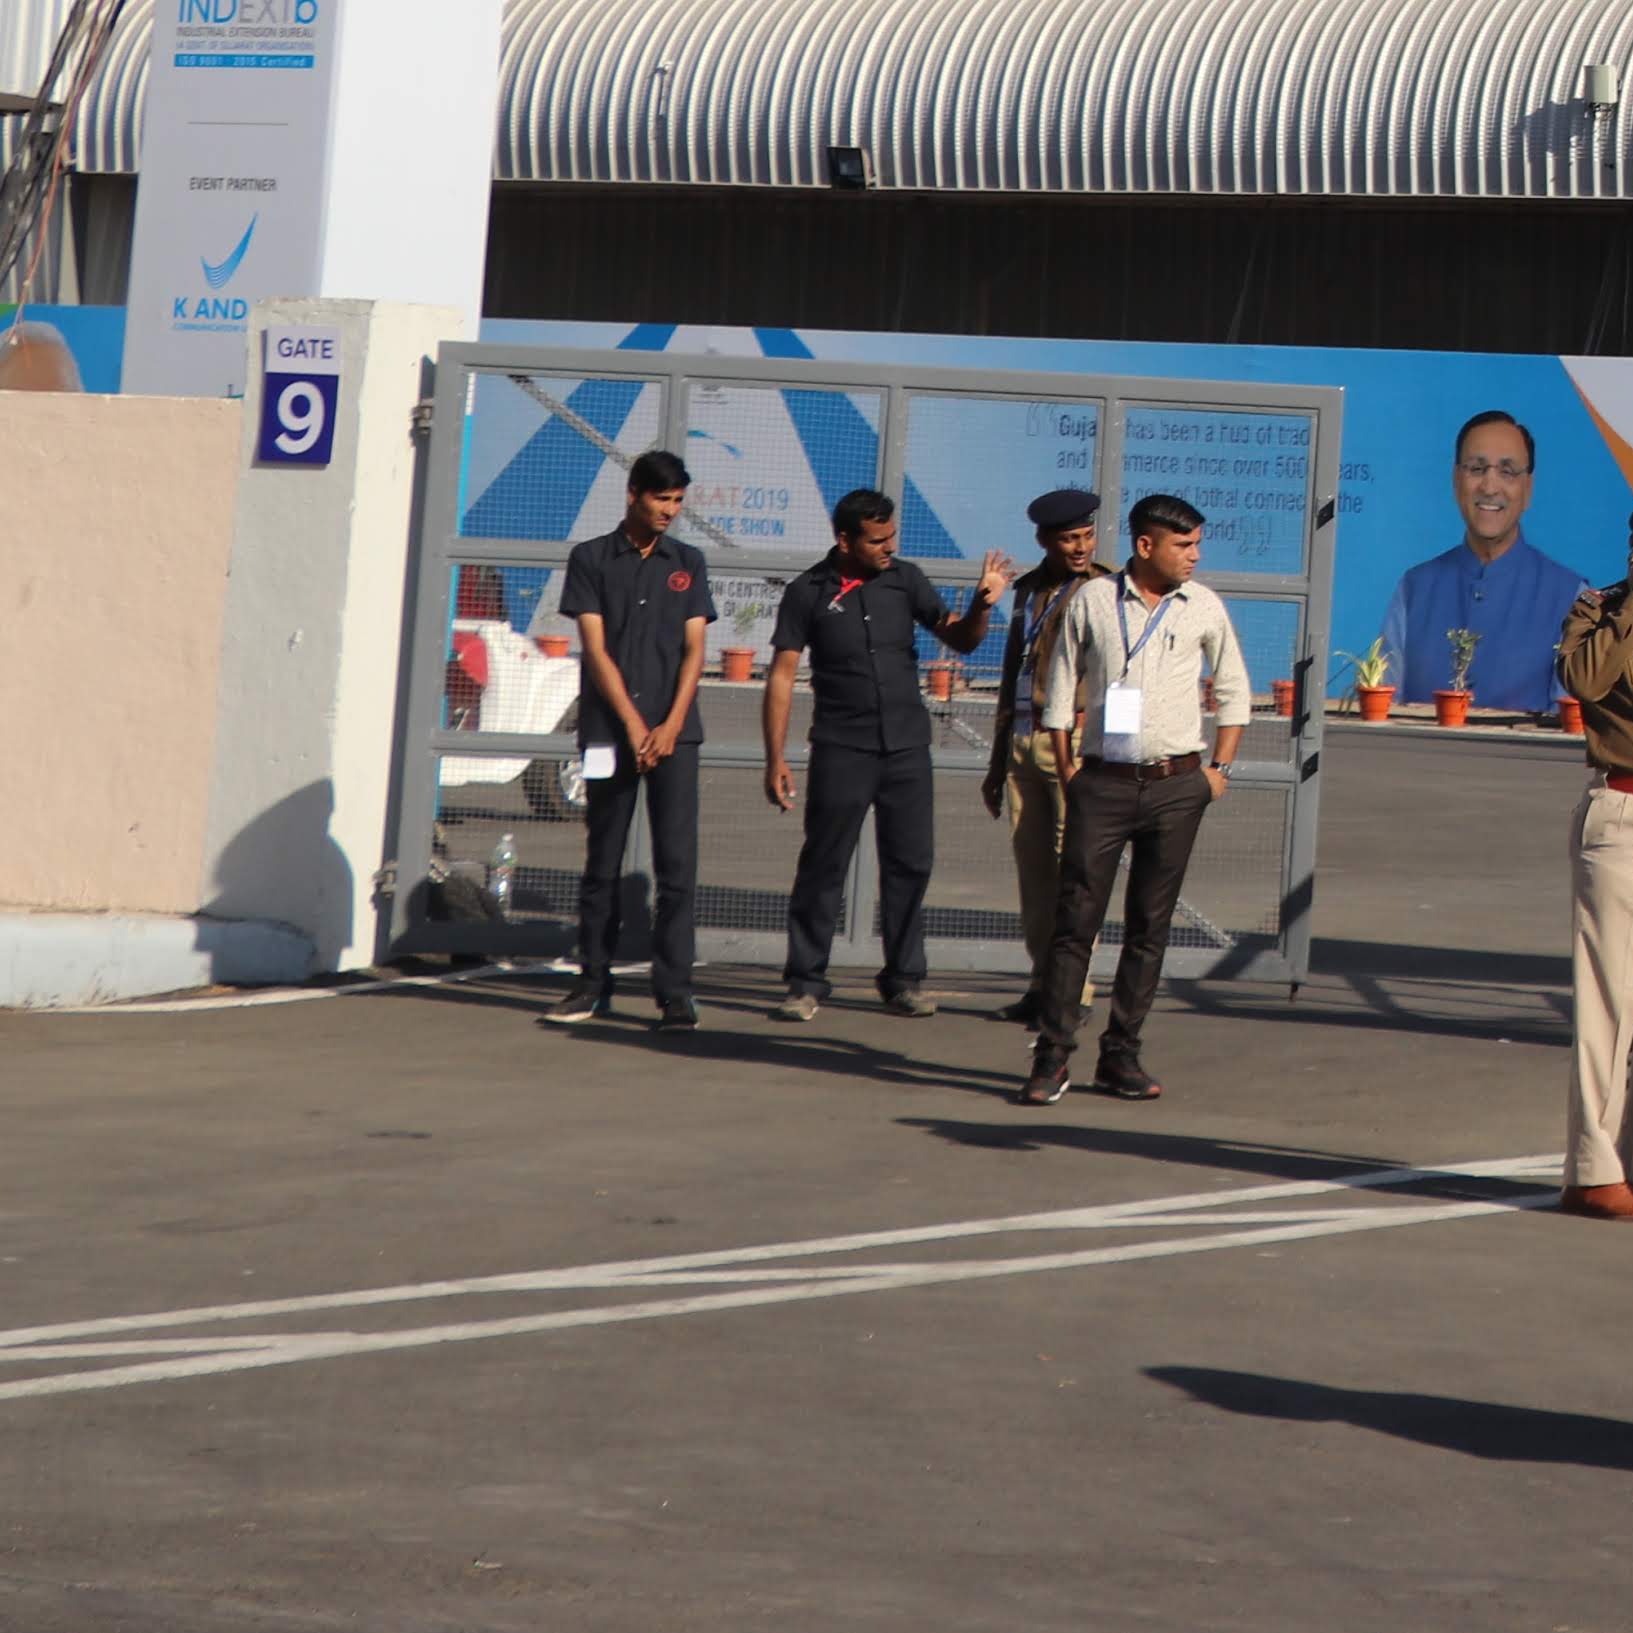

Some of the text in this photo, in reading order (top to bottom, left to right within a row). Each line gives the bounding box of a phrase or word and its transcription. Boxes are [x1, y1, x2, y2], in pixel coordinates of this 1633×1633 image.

[189, 177, 277, 192] EVENT PARTNER
[173, 298, 247, 320] K AND
[277, 338, 334, 359] GATE
[274, 381, 325, 455] 9
[1060, 415, 1097, 441] Guja
[1126, 417, 1154, 439] has
[1160, 417, 1200, 442] been
[1205, 425, 1214, 443] a
[1256, 424, 1272, 444] of
[1278, 425, 1311, 446] trad
[1057, 447, 1087, 469] and
[1275, 456, 1307, 479] 500
[1338, 462, 1375, 484] ears,
[742, 487, 789, 510] 2019
